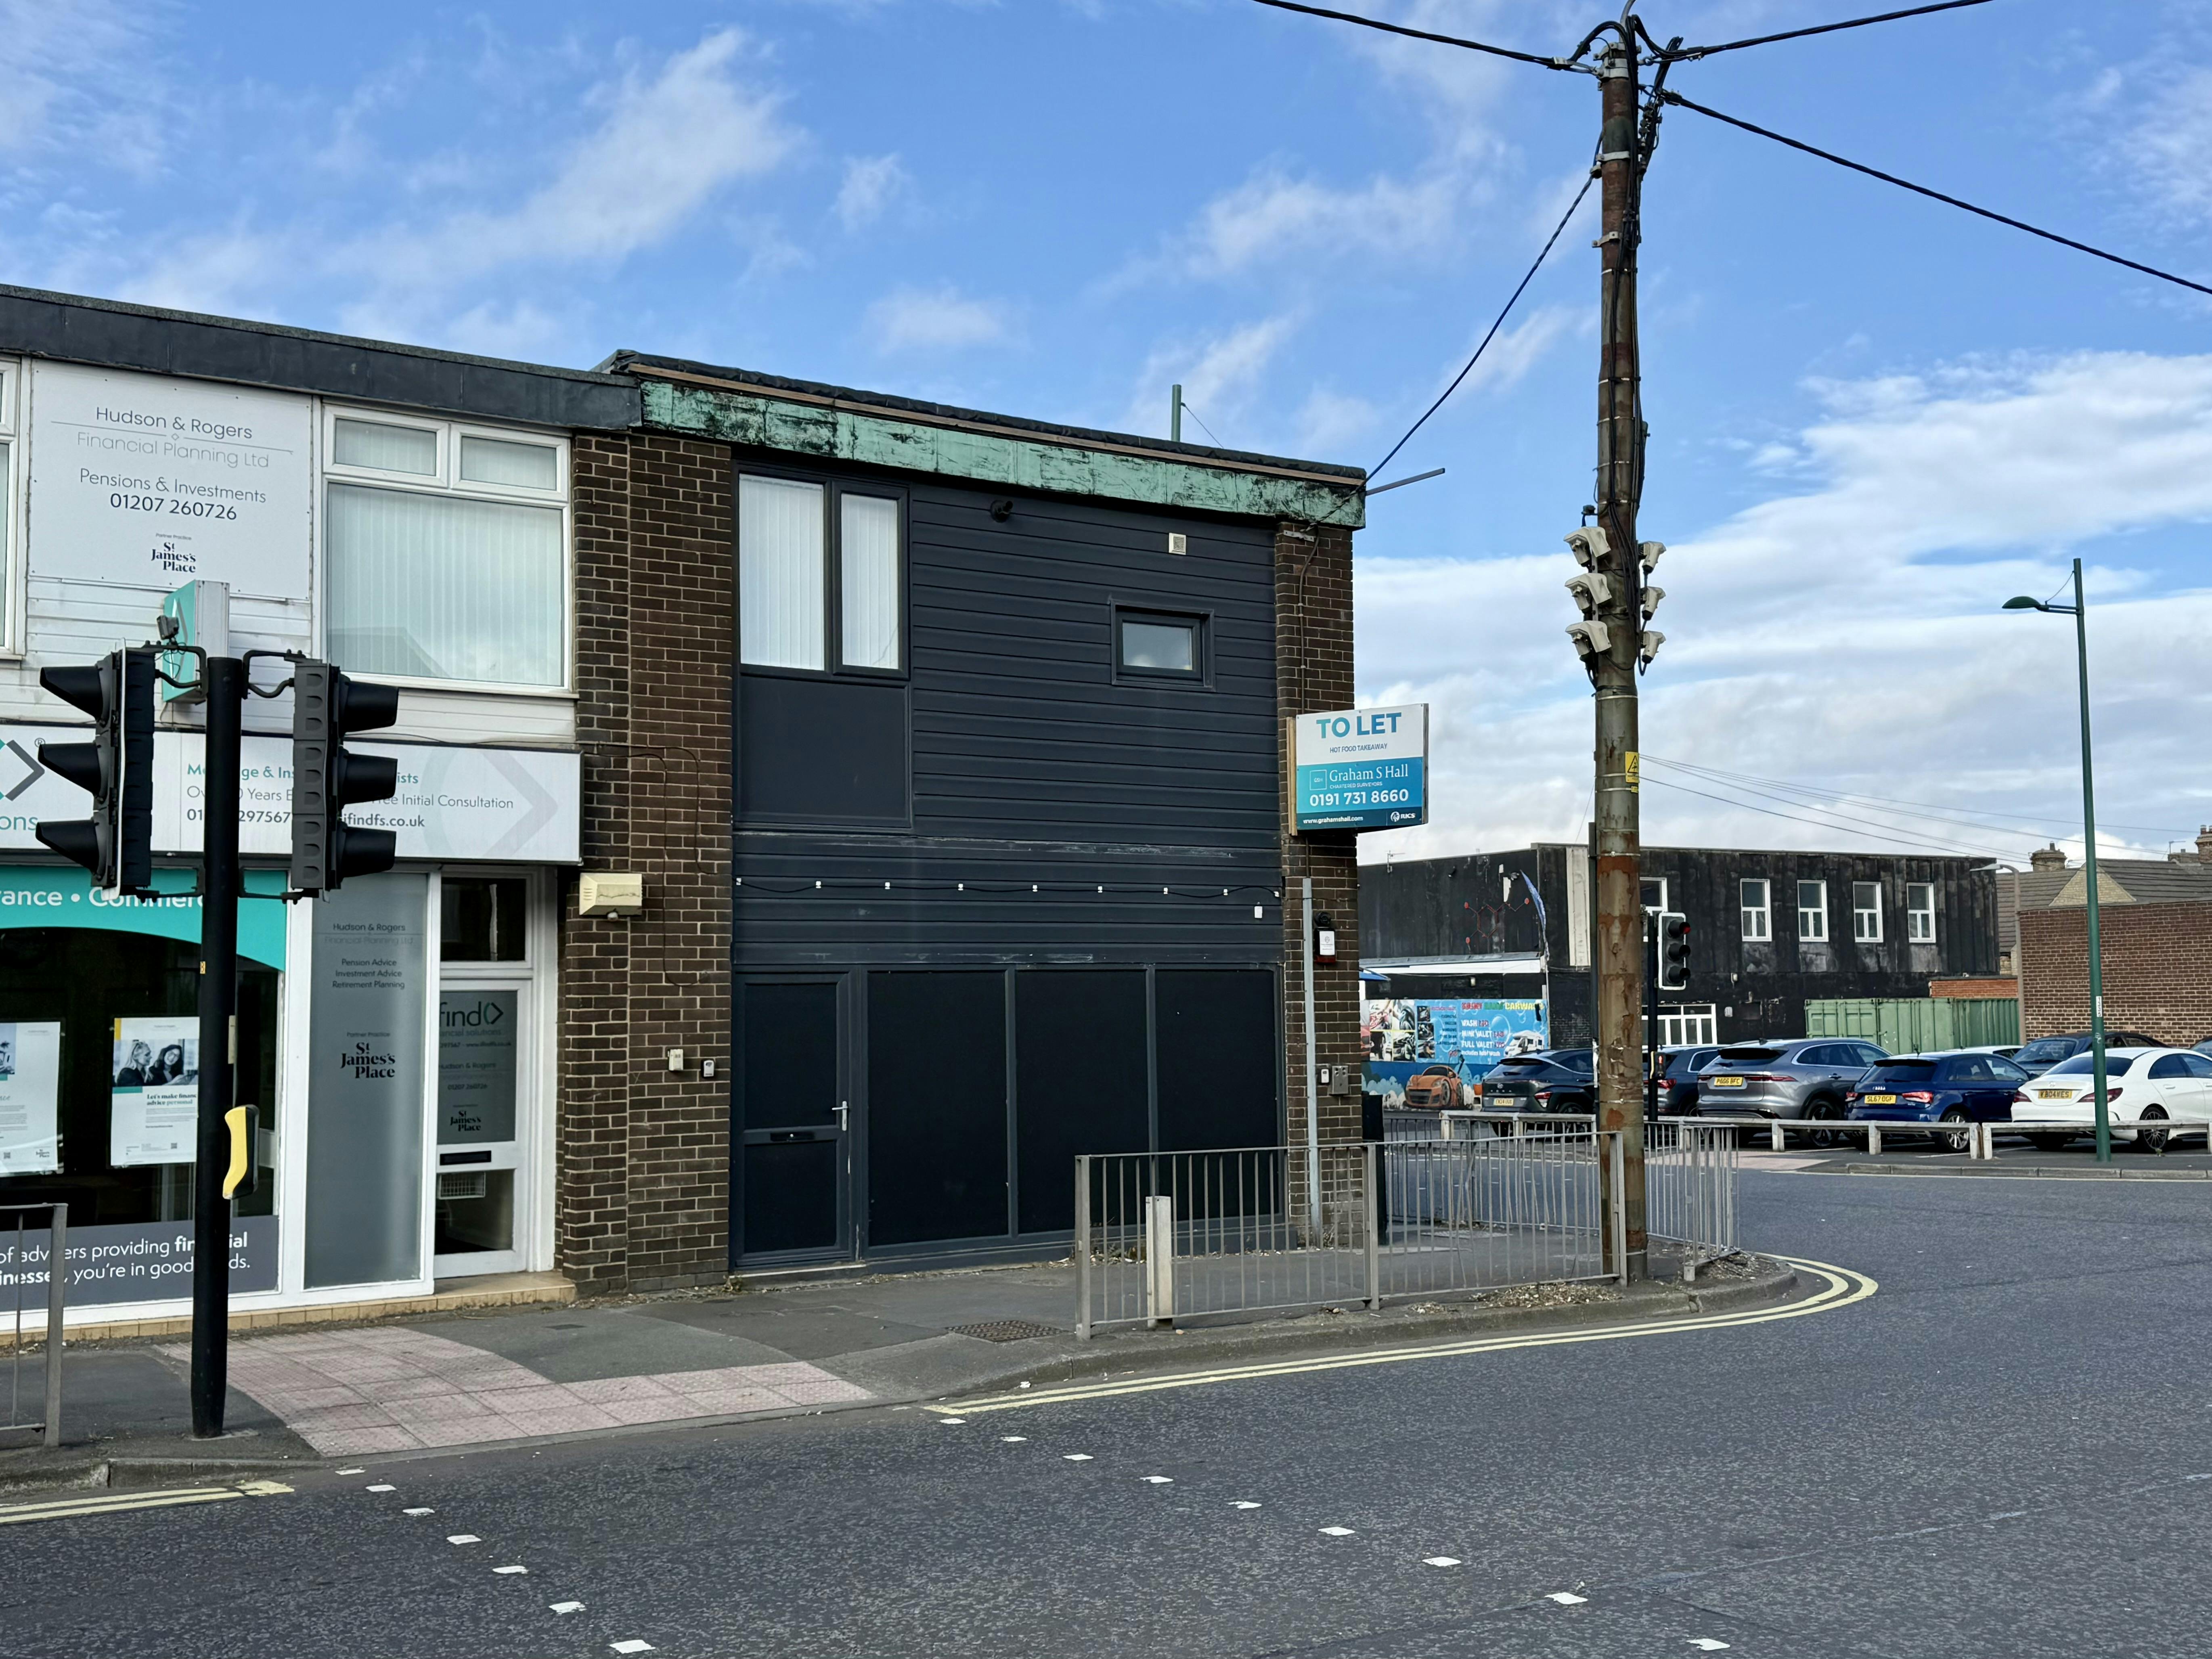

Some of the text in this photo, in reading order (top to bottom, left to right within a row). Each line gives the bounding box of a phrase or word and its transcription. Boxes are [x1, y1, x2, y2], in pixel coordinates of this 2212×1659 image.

[96, 407, 253, 440] Hudson & Rogers
[78, 432, 269, 468] Financial Planning Ltd
[80, 468, 266, 503] Pensions & Investments
[110, 493, 237, 520] 01207 260726
[151, 549, 196, 563] James's
[163, 560, 196, 573] Place
[1316, 712, 1402, 739] TO LET
[1357, 743, 1388, 751] TAKEAWAY
[263, 766, 274, 778] &
[1329, 764, 1408, 782] Graham S Hall
[247, 788, 282, 800] Years
[402, 794, 434, 806] Initial
[438, 794, 513, 809] Consultation
[1309, 789, 1409, 806] 0191 731 8660
[1303, 816, 1364, 824] www.grahamshall.com
[376, 924, 406, 933] Rogers
[332, 980, 405, 990] Retirement Planning
[340, 1053, 396, 1069] James's
[355, 1066, 395, 1079] Place
[458, 1124, 481, 1132] Place
[92, 1238, 170, 1261] providing
[73, 1263, 126, 1285] you're
[131, 1263, 145, 1277] in
[150, 1256, 194, 1279] good
